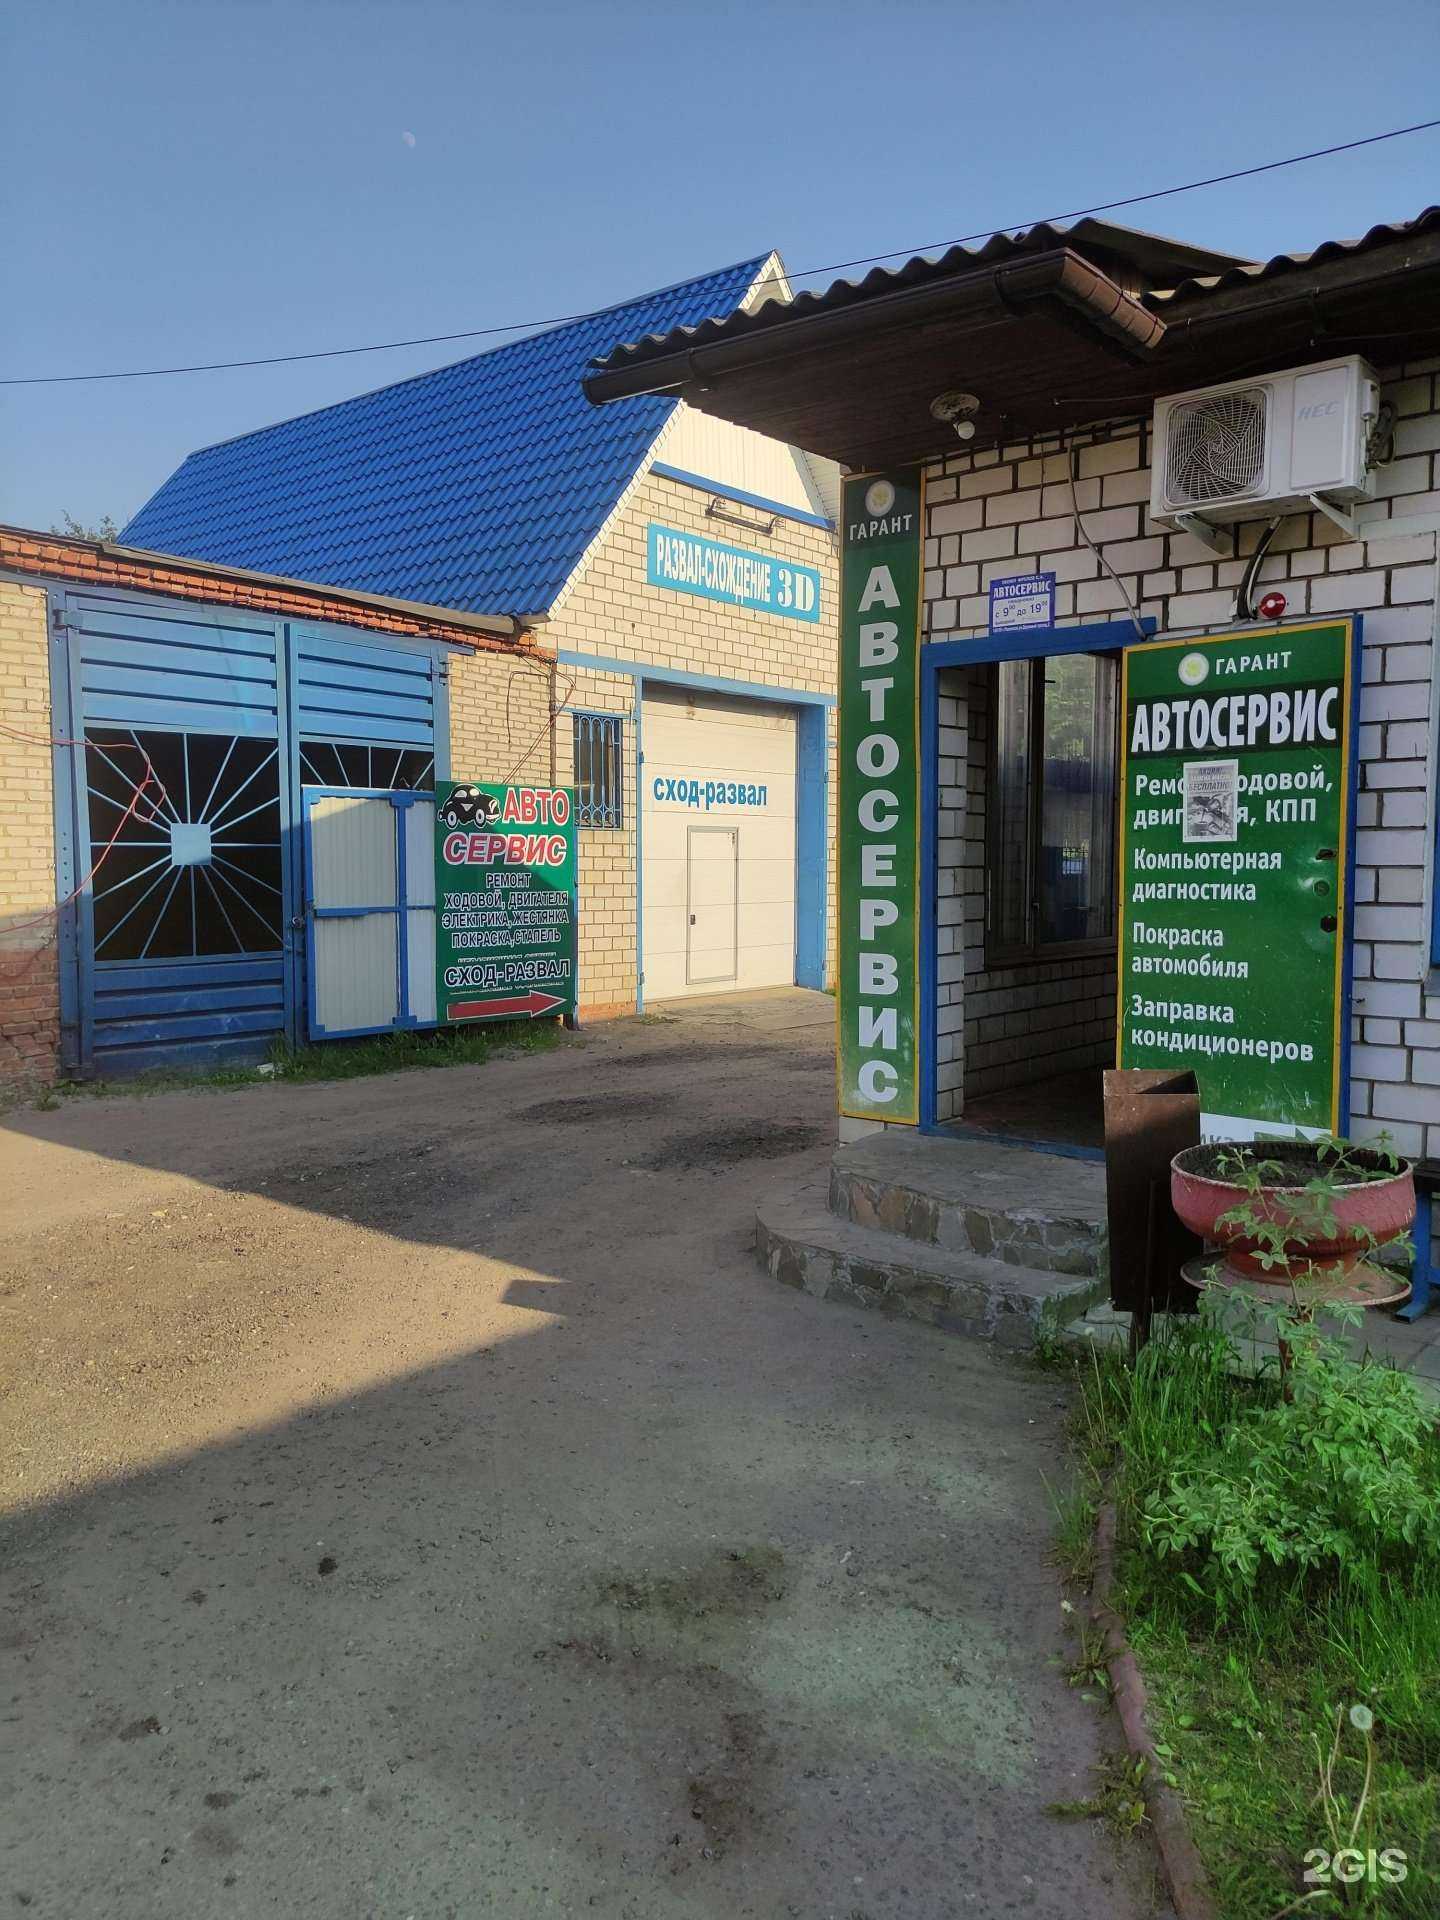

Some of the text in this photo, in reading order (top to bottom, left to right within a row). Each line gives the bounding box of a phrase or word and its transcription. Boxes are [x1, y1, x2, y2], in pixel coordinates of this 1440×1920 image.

[849, 514, 913, 541] ГАРАНТ
[656, 534, 815, 612] РАЗВАЛ-СХОЖДЕНИЕ 3D
[993, 581, 1052, 599] АВТОСЕРВИС
[1016, 609, 1027, 617] до
[1215, 652, 1292, 676] ГАРАНТ
[1131, 687, 1339, 753] АВТОСЕРВИС
[502, 787, 570, 824] АВТО
[653, 777, 767, 810] сход-развал
[1265, 798, 1316, 822] КПП
[856, 565, 902, 1104] АВТОСЕРВИС
[443, 832, 567, 866] СЕРВИС
[1134, 848, 1282, 875] Компьютерная
[486, 873, 532, 888] РЕМОНТ
[1132, 882, 1256, 903] диагностика
[444, 889, 569, 911] ХОДОВОЙ, ДВИГАТЕЛЯ
[1132, 922, 1224, 950] Покраска
[444, 959, 571, 988] СХОД-РАЗВАЛ
[1131, 953, 1249, 979] автомобиля
[1130, 994, 1234, 1024] Заправка
[1130, 1028, 1314, 1064] кондиционеров
